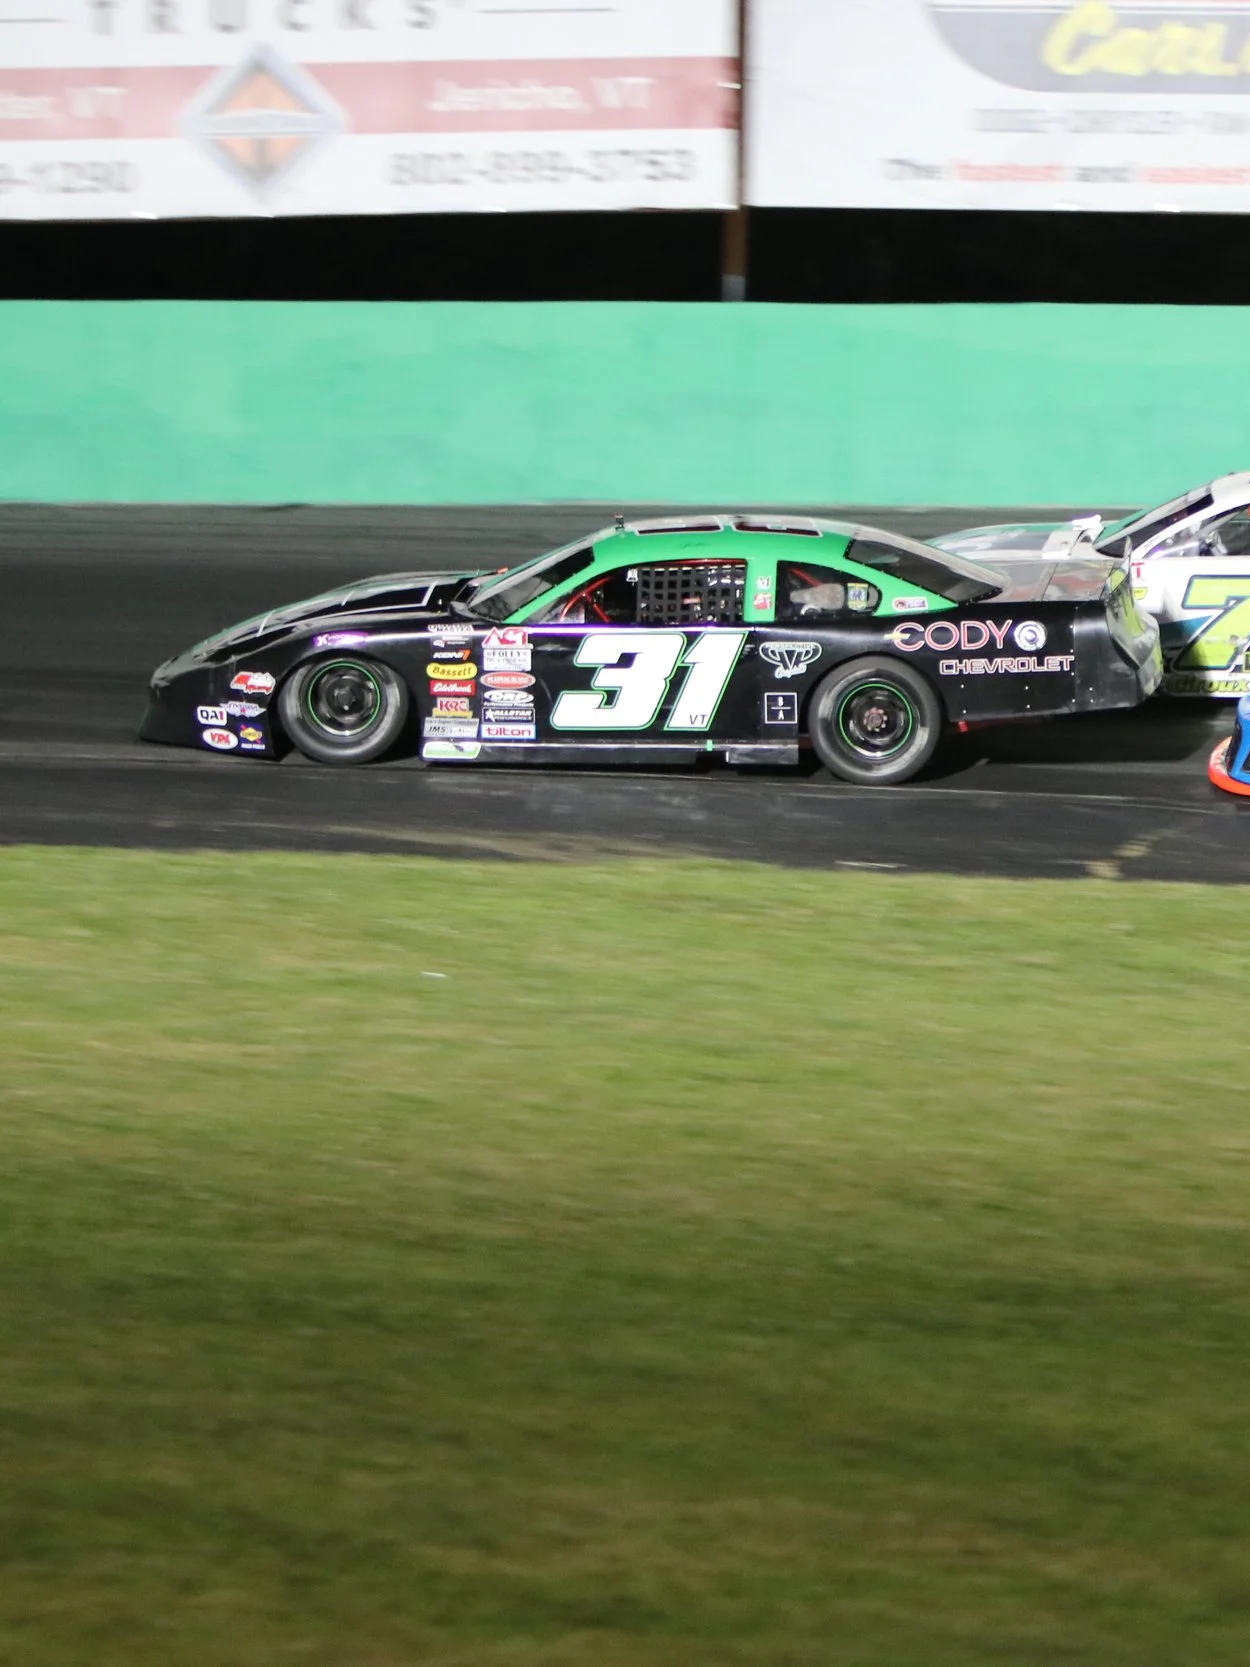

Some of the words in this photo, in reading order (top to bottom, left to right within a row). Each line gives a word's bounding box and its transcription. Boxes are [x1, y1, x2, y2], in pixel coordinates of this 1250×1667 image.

[893, 619, 1013, 652] CODY
[939, 655, 1075, 675] CHEVROLET
[432, 666, 472, 677] Bassett
[550, 630, 750, 731] 31
[199, 709, 225, 722] QA1
[688, 714, 708, 726] VT
[778, 709, 784, 720] A
[486, 727, 531, 736] tilton
